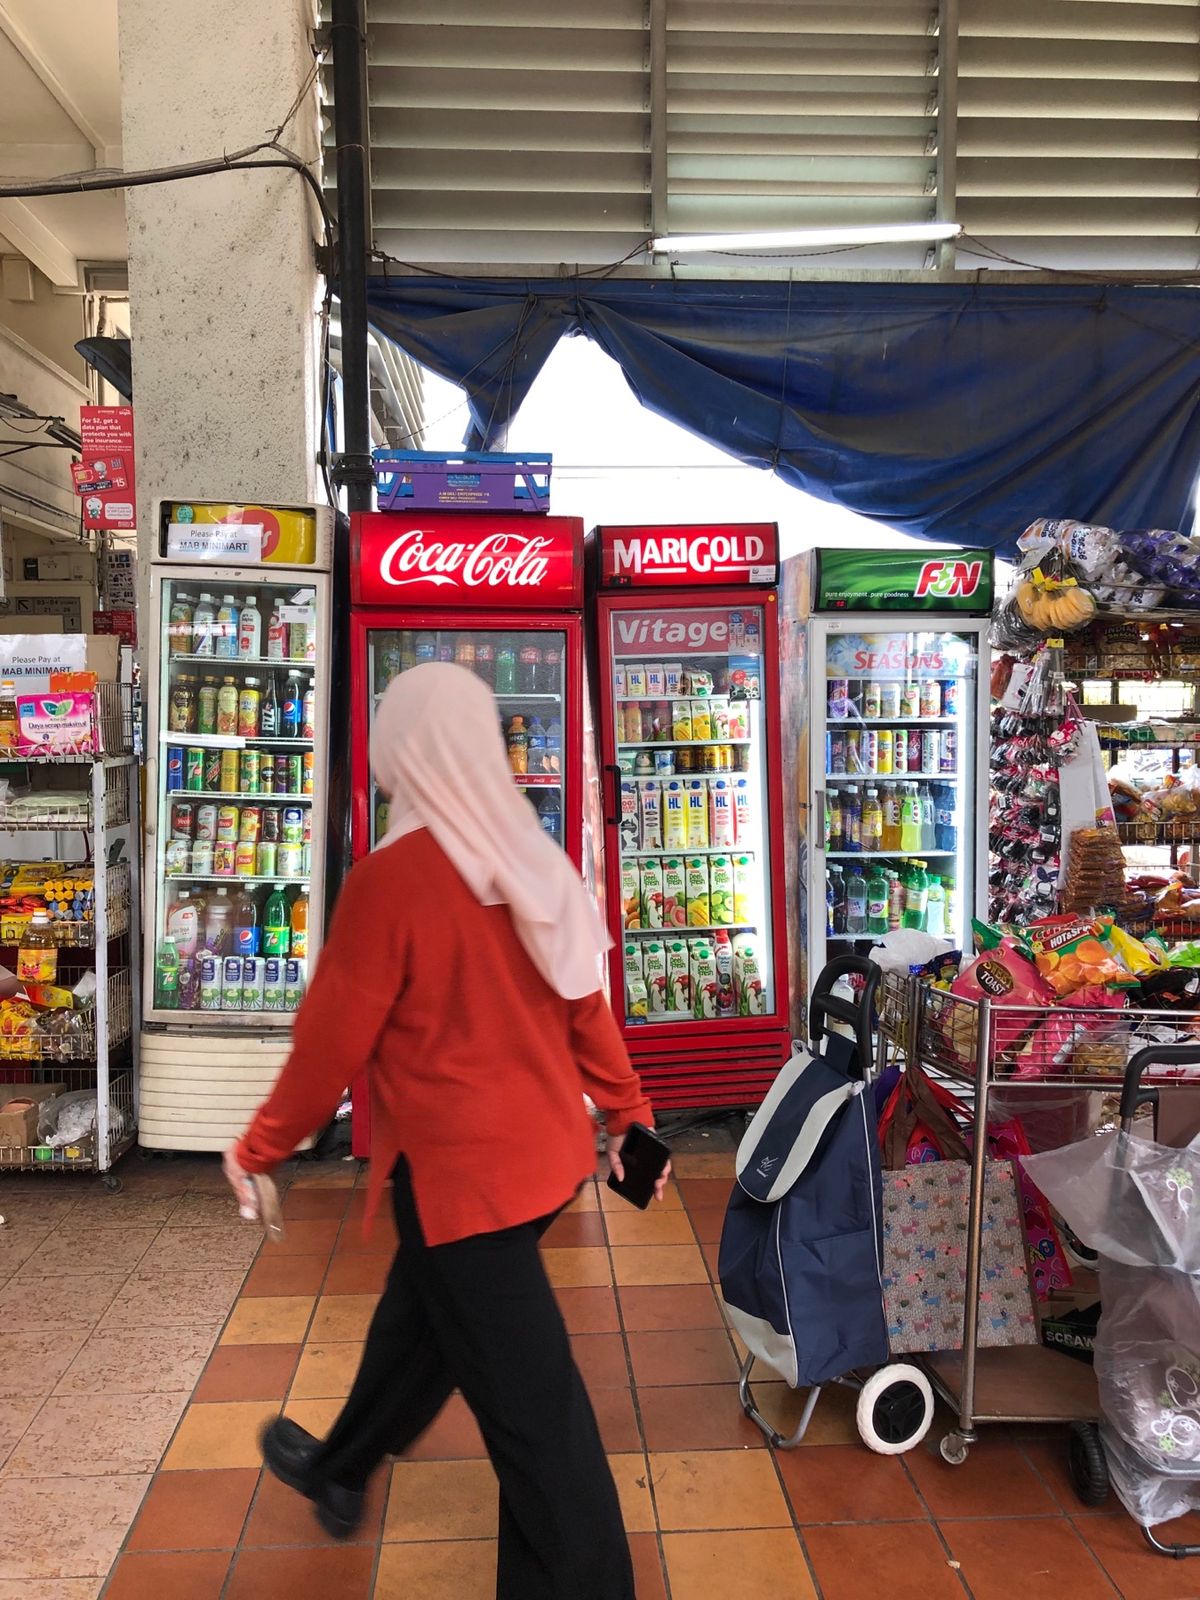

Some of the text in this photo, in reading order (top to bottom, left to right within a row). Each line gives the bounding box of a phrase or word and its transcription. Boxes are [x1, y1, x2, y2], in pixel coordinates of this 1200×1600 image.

[180, 541, 200, 549] MAB
[380, 530, 554, 586] Coca-Cola
[613, 536, 764, 574] MARIGOLD
[914, 560, 983, 597] F&N
[618, 618, 728, 647] Vitage
[12, 656, 36, 664] Please
[38, 656, 51, 664] Pay
[668, 797, 681, 809] HL
[690, 796, 702, 808] HL
[716, 796, 728, 808] HL
[981, 971, 1006, 994] TOAST
